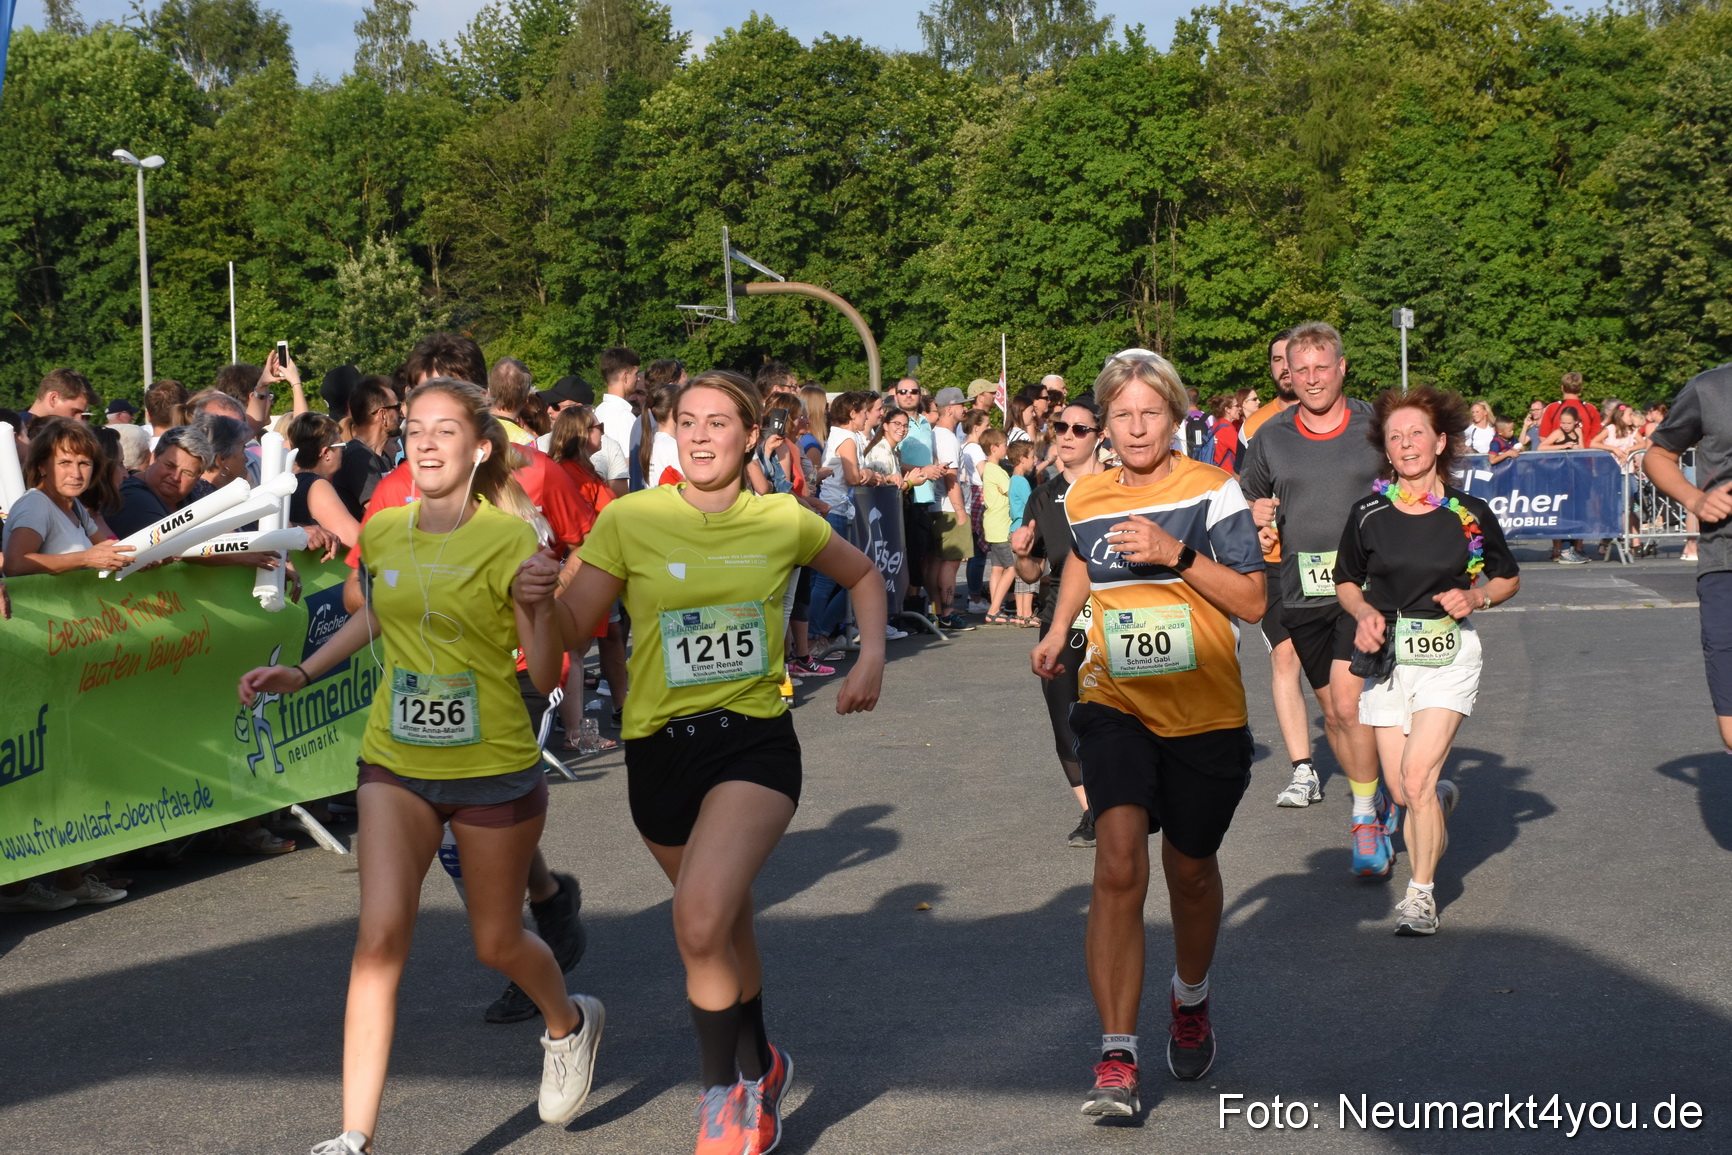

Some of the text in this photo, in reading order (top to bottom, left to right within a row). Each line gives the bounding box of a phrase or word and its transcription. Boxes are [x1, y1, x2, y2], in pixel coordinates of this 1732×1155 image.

[1479, 489, 1569, 515] cher
[1308, 568, 1334, 584] 14
[48, 590, 187, 656] Gesunde Firmen
[740, 621, 759, 631] 2019
[1167, 622, 1185, 630] 2019
[78, 613, 211, 694] laufen länger!
[676, 630, 754, 664] 1215
[1120, 631, 1171, 658] 780
[1404, 632, 1456, 654] 1968
[691, 660, 744, 672] Eimer Renate
[1126, 655, 1171, 666] Schmid Gabi
[1164, 660, 1180, 668] GmbH
[693, 670, 717, 678] Klinikum
[717, 667, 743, 675] Neumarkt
[278, 657, 385, 744] firmenlau
[399, 696, 466, 727] 1256
[422, 725, 465, 734] Anna-Maria
[288, 725, 339, 765] neumarkt
